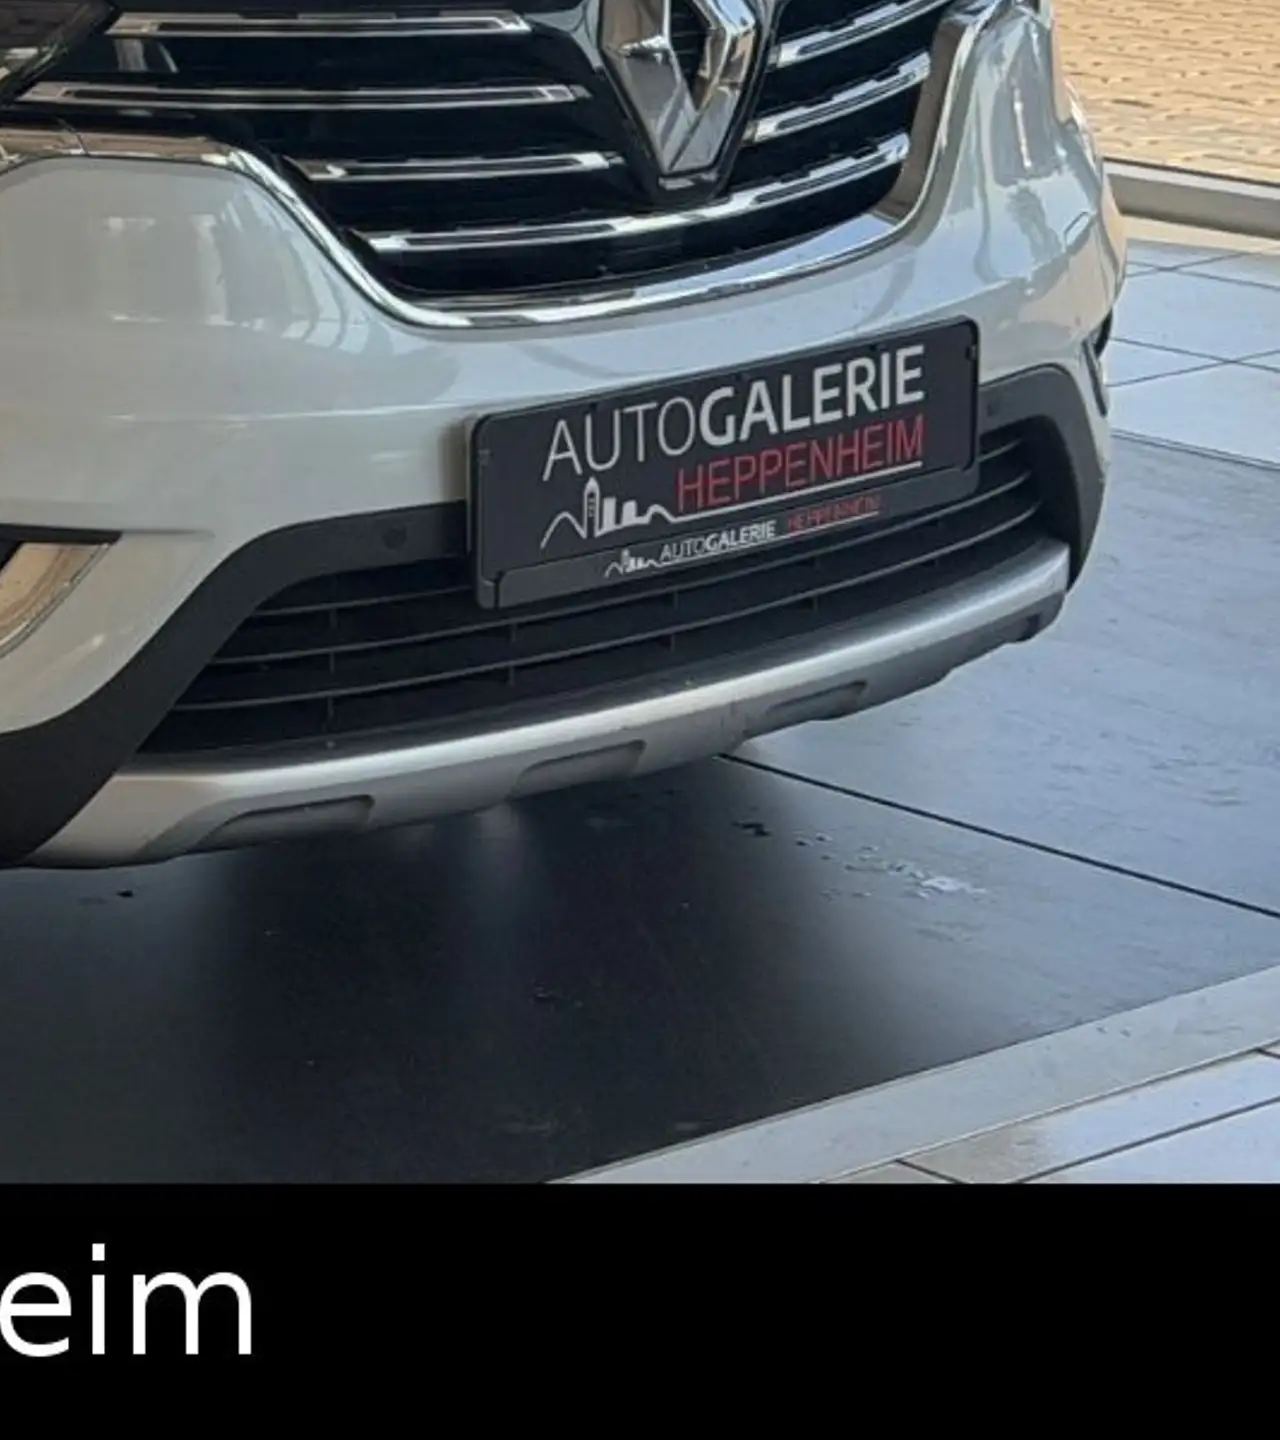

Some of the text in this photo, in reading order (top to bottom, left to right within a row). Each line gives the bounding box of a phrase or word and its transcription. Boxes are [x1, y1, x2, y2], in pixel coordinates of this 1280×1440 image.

[542, 343, 926, 482] AUTOGALERIE
[677, 412, 925, 513] HEPPENHEIM
[658, 519, 778, 562] AUTOGALERIE
